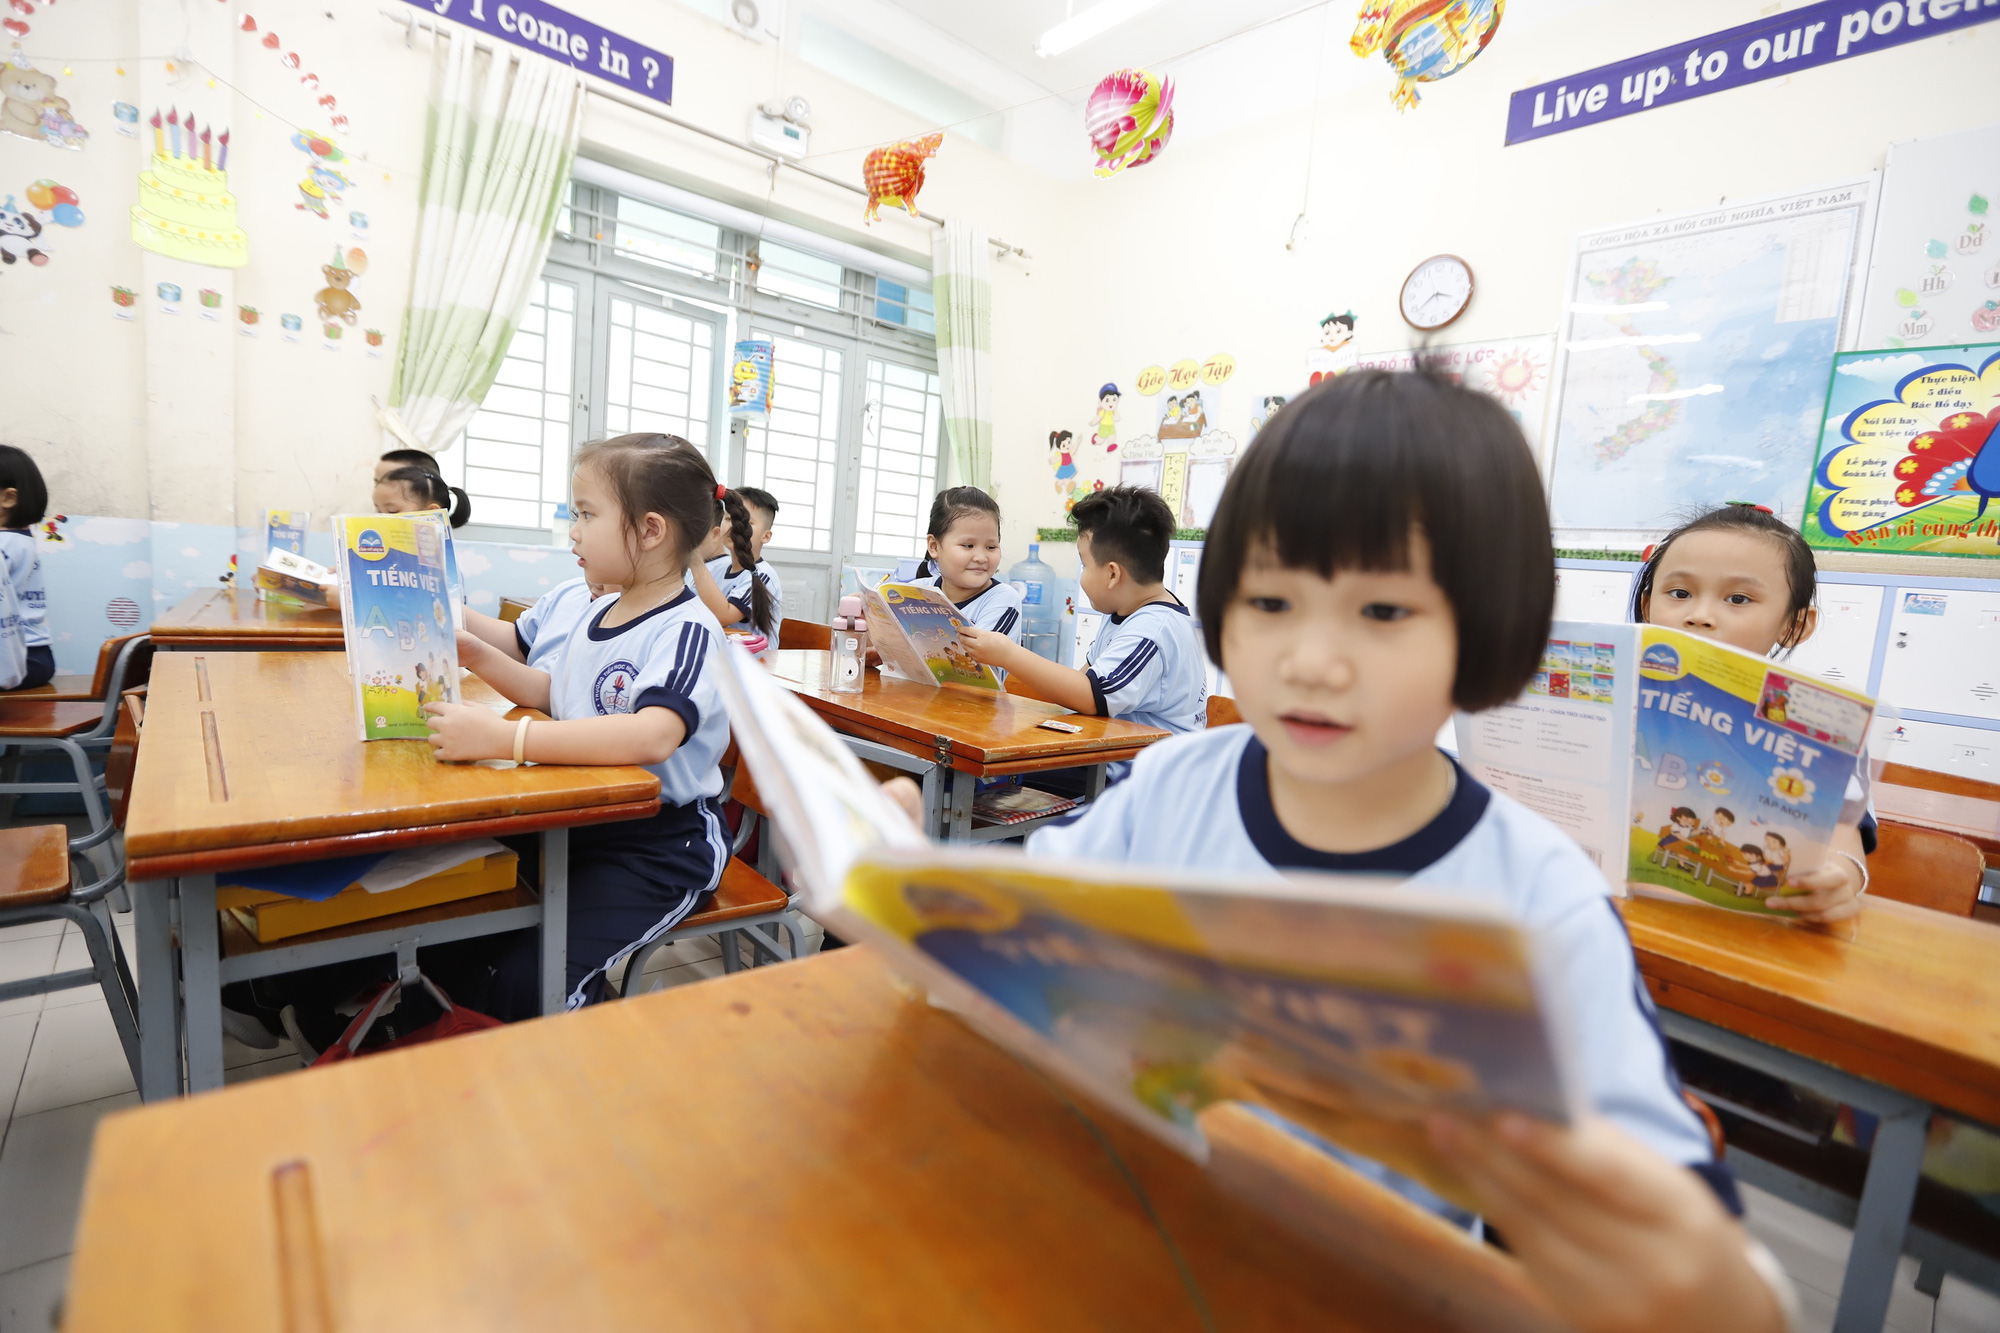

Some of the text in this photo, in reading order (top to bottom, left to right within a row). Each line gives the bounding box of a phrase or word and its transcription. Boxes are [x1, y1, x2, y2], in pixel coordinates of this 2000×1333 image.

[497, 5, 589, 62] come
[599, 37, 630, 80] in
[1532, 83, 1609, 128] Live
[1620, 65, 1672, 108] up
[1684, 48, 1728, 88] to
[1742, 20, 1826, 71] our
[1780, 198, 1815, 213] VIỆT
[1817, 191, 1853, 206] NAM
[1138, 362, 1233, 391] Góc Học Tập
[1920, 374, 1976, 385] Thực hiện
[1937, 386, 1962, 395] điều
[1910, 399, 1974, 410] Bác Hồ dạy
[1899, 417, 1919, 427] hay
[1861, 457, 1888, 468] phép
[1838, 497, 1867, 507] Trang
[1843, 525, 1890, 547] Bạn
[1896, 519, 1916, 537] ơi
[1921, 517, 1974, 541] cùng
[366, 563, 441, 598] TIẾNG VIỆT
[899, 603, 954, 617] TIẾNG VIỆT
[1641, 689, 1822, 769] TIẾNG VIỆT
